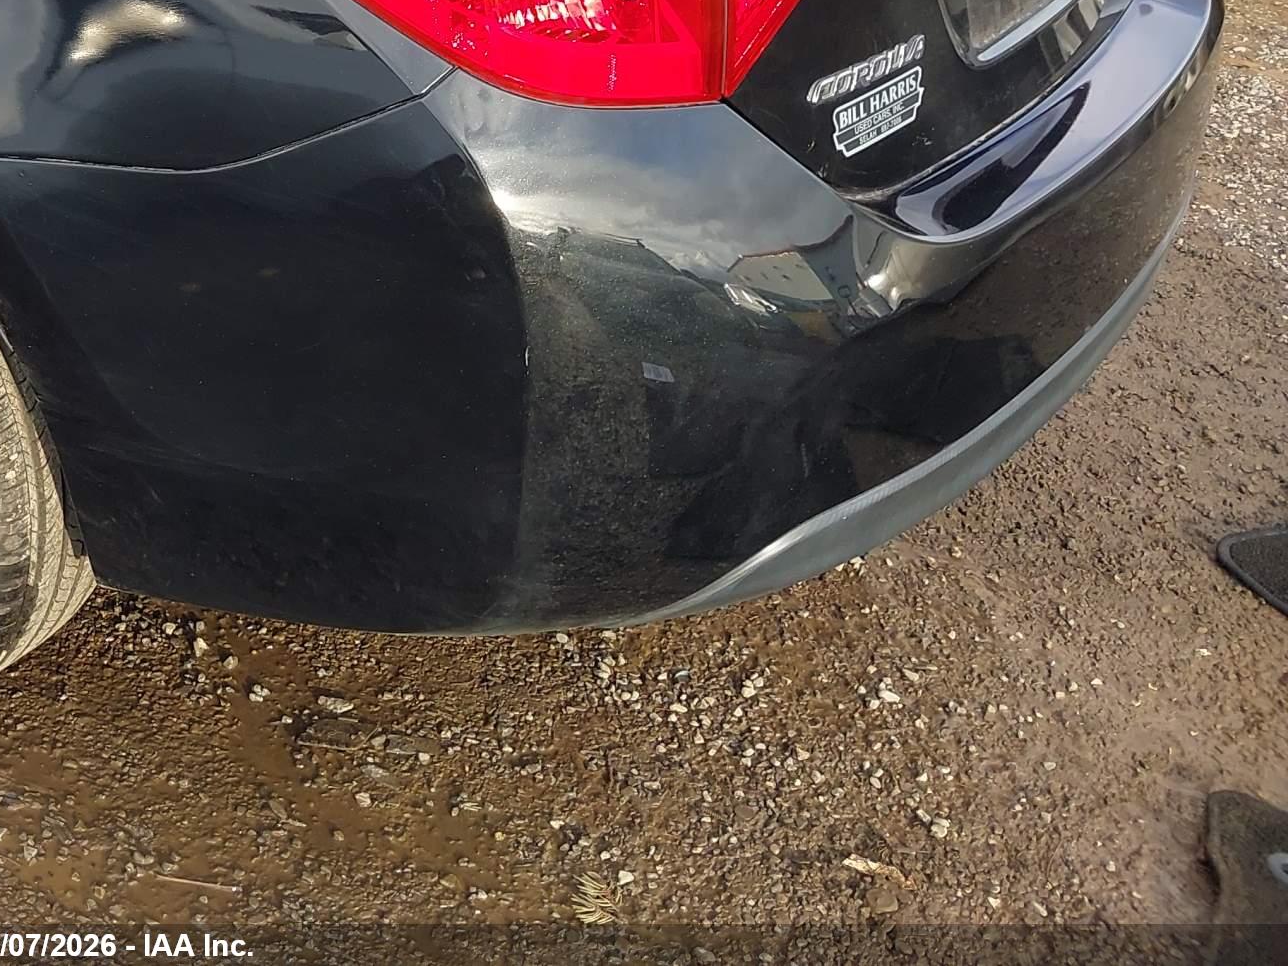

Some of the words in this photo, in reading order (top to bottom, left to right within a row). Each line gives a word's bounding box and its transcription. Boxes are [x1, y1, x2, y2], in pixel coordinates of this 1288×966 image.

[806, 34, 925, 104] COROLLA
[838, 109, 868, 130] BILL
[870, 74, 917, 113] HARRIS
[854, 118, 873, 135] USED
